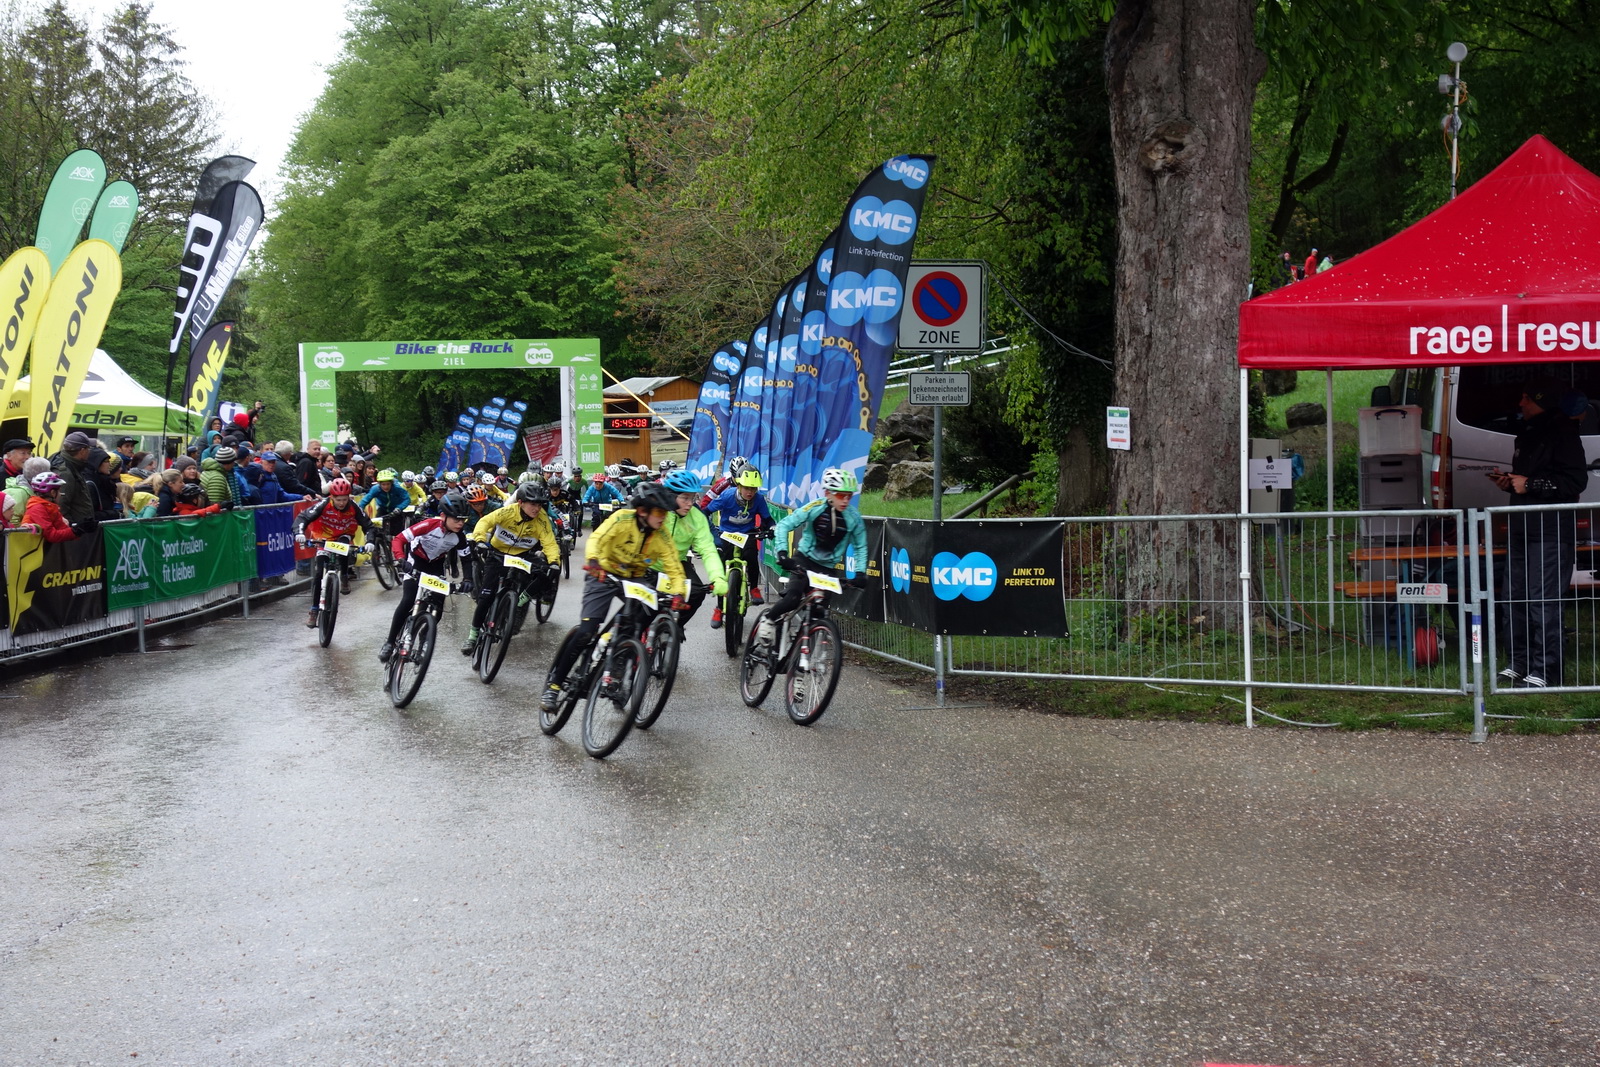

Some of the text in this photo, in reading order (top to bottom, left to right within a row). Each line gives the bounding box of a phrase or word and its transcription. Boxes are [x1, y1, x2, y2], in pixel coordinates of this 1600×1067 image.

[69, 166, 95, 179] AOK
[887, 158, 927, 182] KMC
[108, 195, 130, 205] AOK
[853, 209, 913, 233] KMC
[849, 246, 863, 255] Link
[871, 249, 904, 262] Perfection
[831, 286, 897, 309] KMC
[0, 263, 34, 389] TONI
[919, 331, 960, 344] ZONE
[1409, 325, 1493, 355] race
[37, 257, 98, 457] CRATONI
[443, 357, 466, 366] ZIEL
[925, 376, 955, 384] Parken in
[912, 384, 968, 395] gekennzeichneten
[915, 393, 964, 402] Flächen erlaubt
[611, 418, 648, 428] 15:45:08
[494, 431, 515, 441] KMC
[582, 452, 600, 463] EMAS
[162, 540, 180, 562] Sport
[112, 538, 149, 581] AOK
[42, 565, 102, 588] CRATONI
[933, 567, 993, 586] KMC
[1013, 568, 1033, 576] LINK
[427, 578, 445, 589] 566
[1004, 577, 1055, 586] PERFECTION
[1400, 584, 1442, 595] rentES
